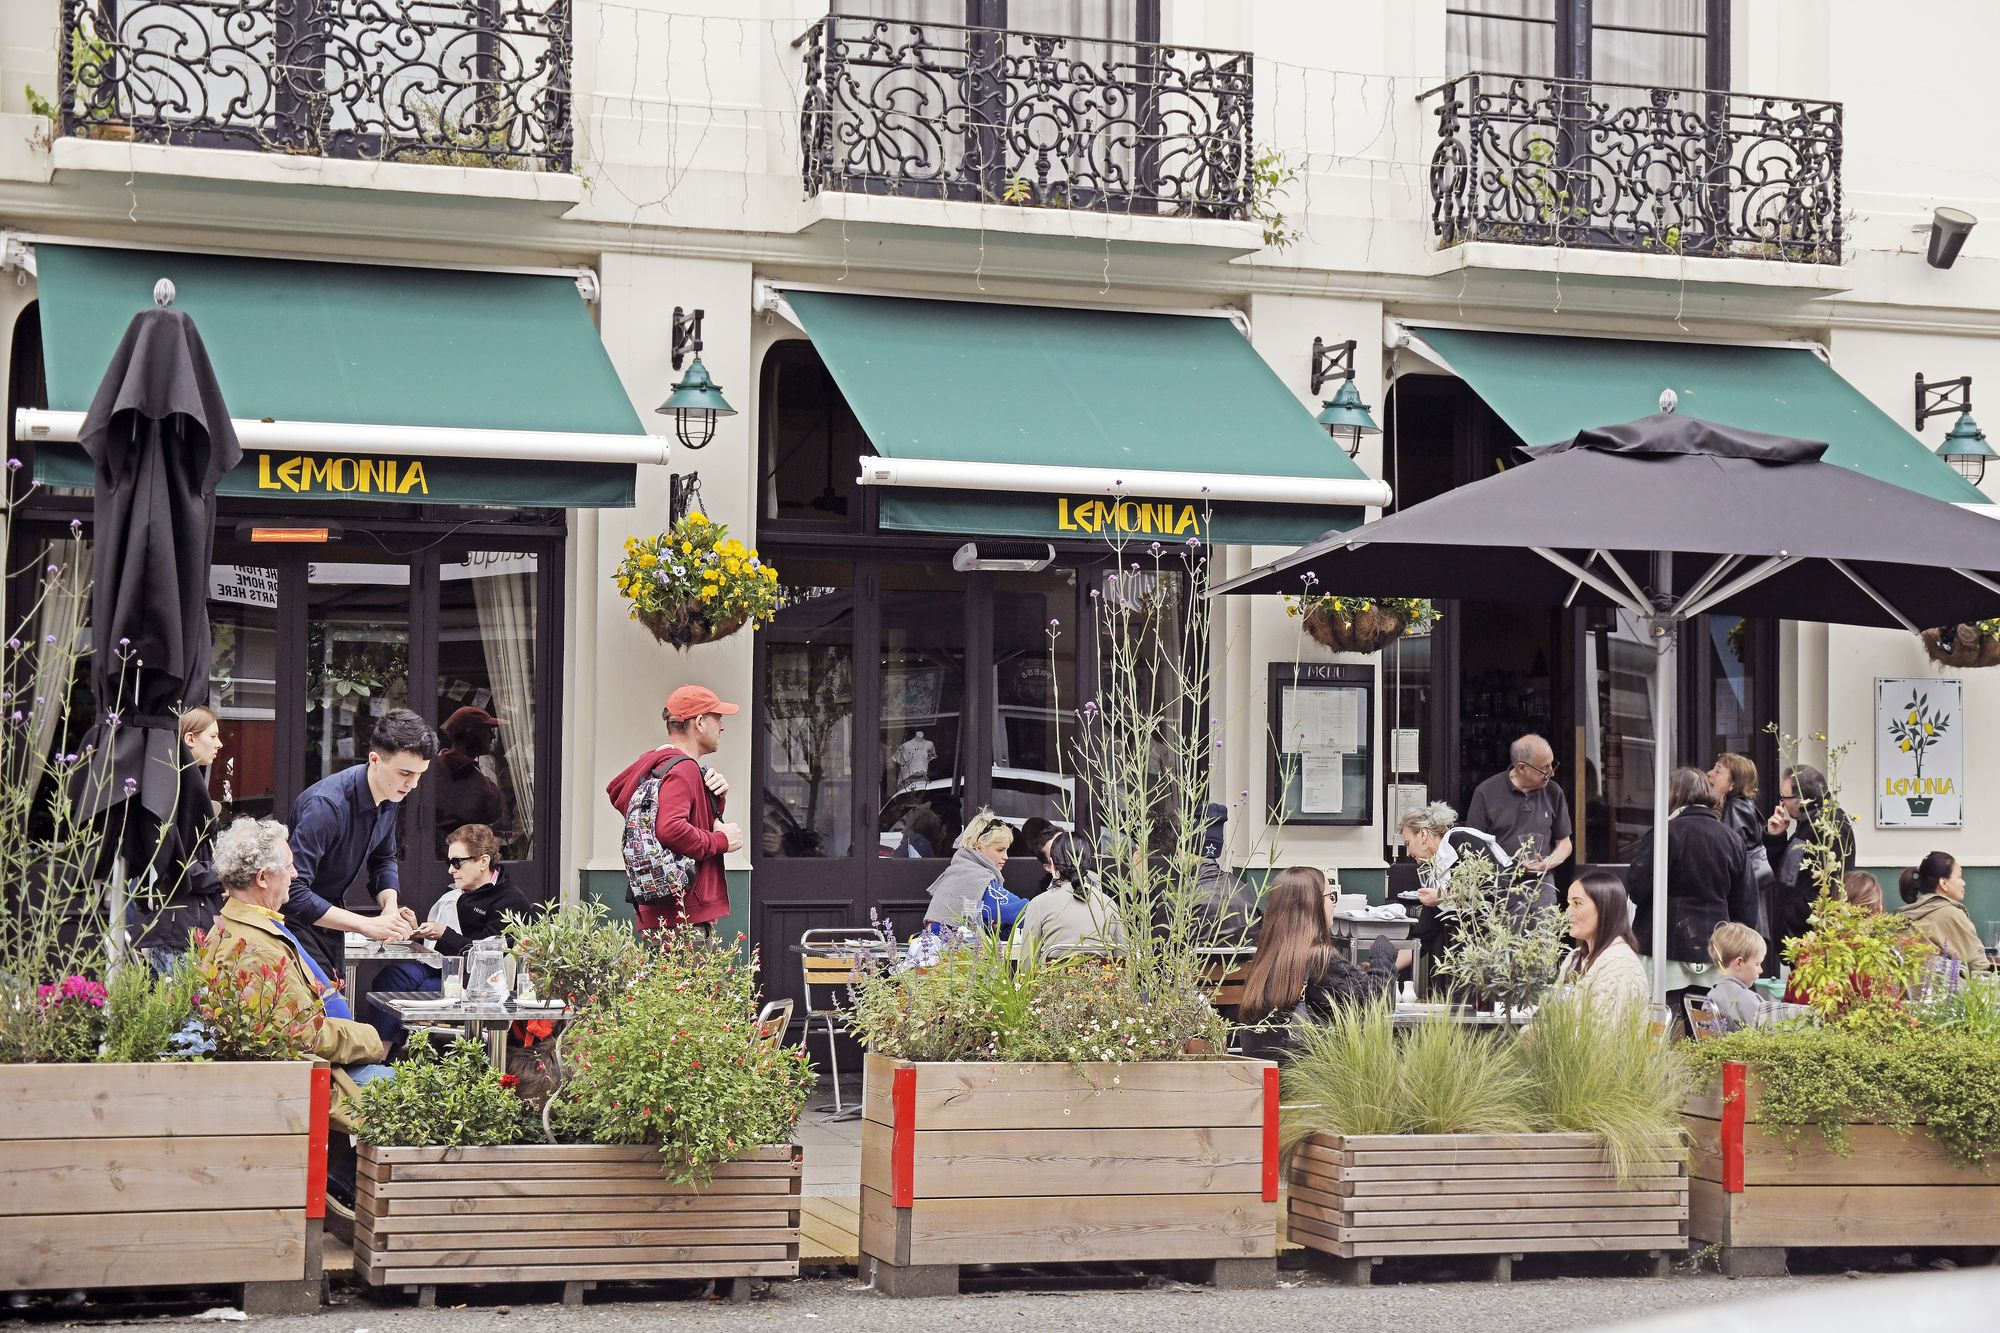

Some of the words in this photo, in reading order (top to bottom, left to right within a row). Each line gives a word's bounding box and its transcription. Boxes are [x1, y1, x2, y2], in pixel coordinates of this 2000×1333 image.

[259, 454, 429, 495] LEMONIA
[1058, 498, 1200, 535] LEMONIA
[1307, 665, 1345, 679] MENU
[1886, 777, 1955, 797] LEMONIA
